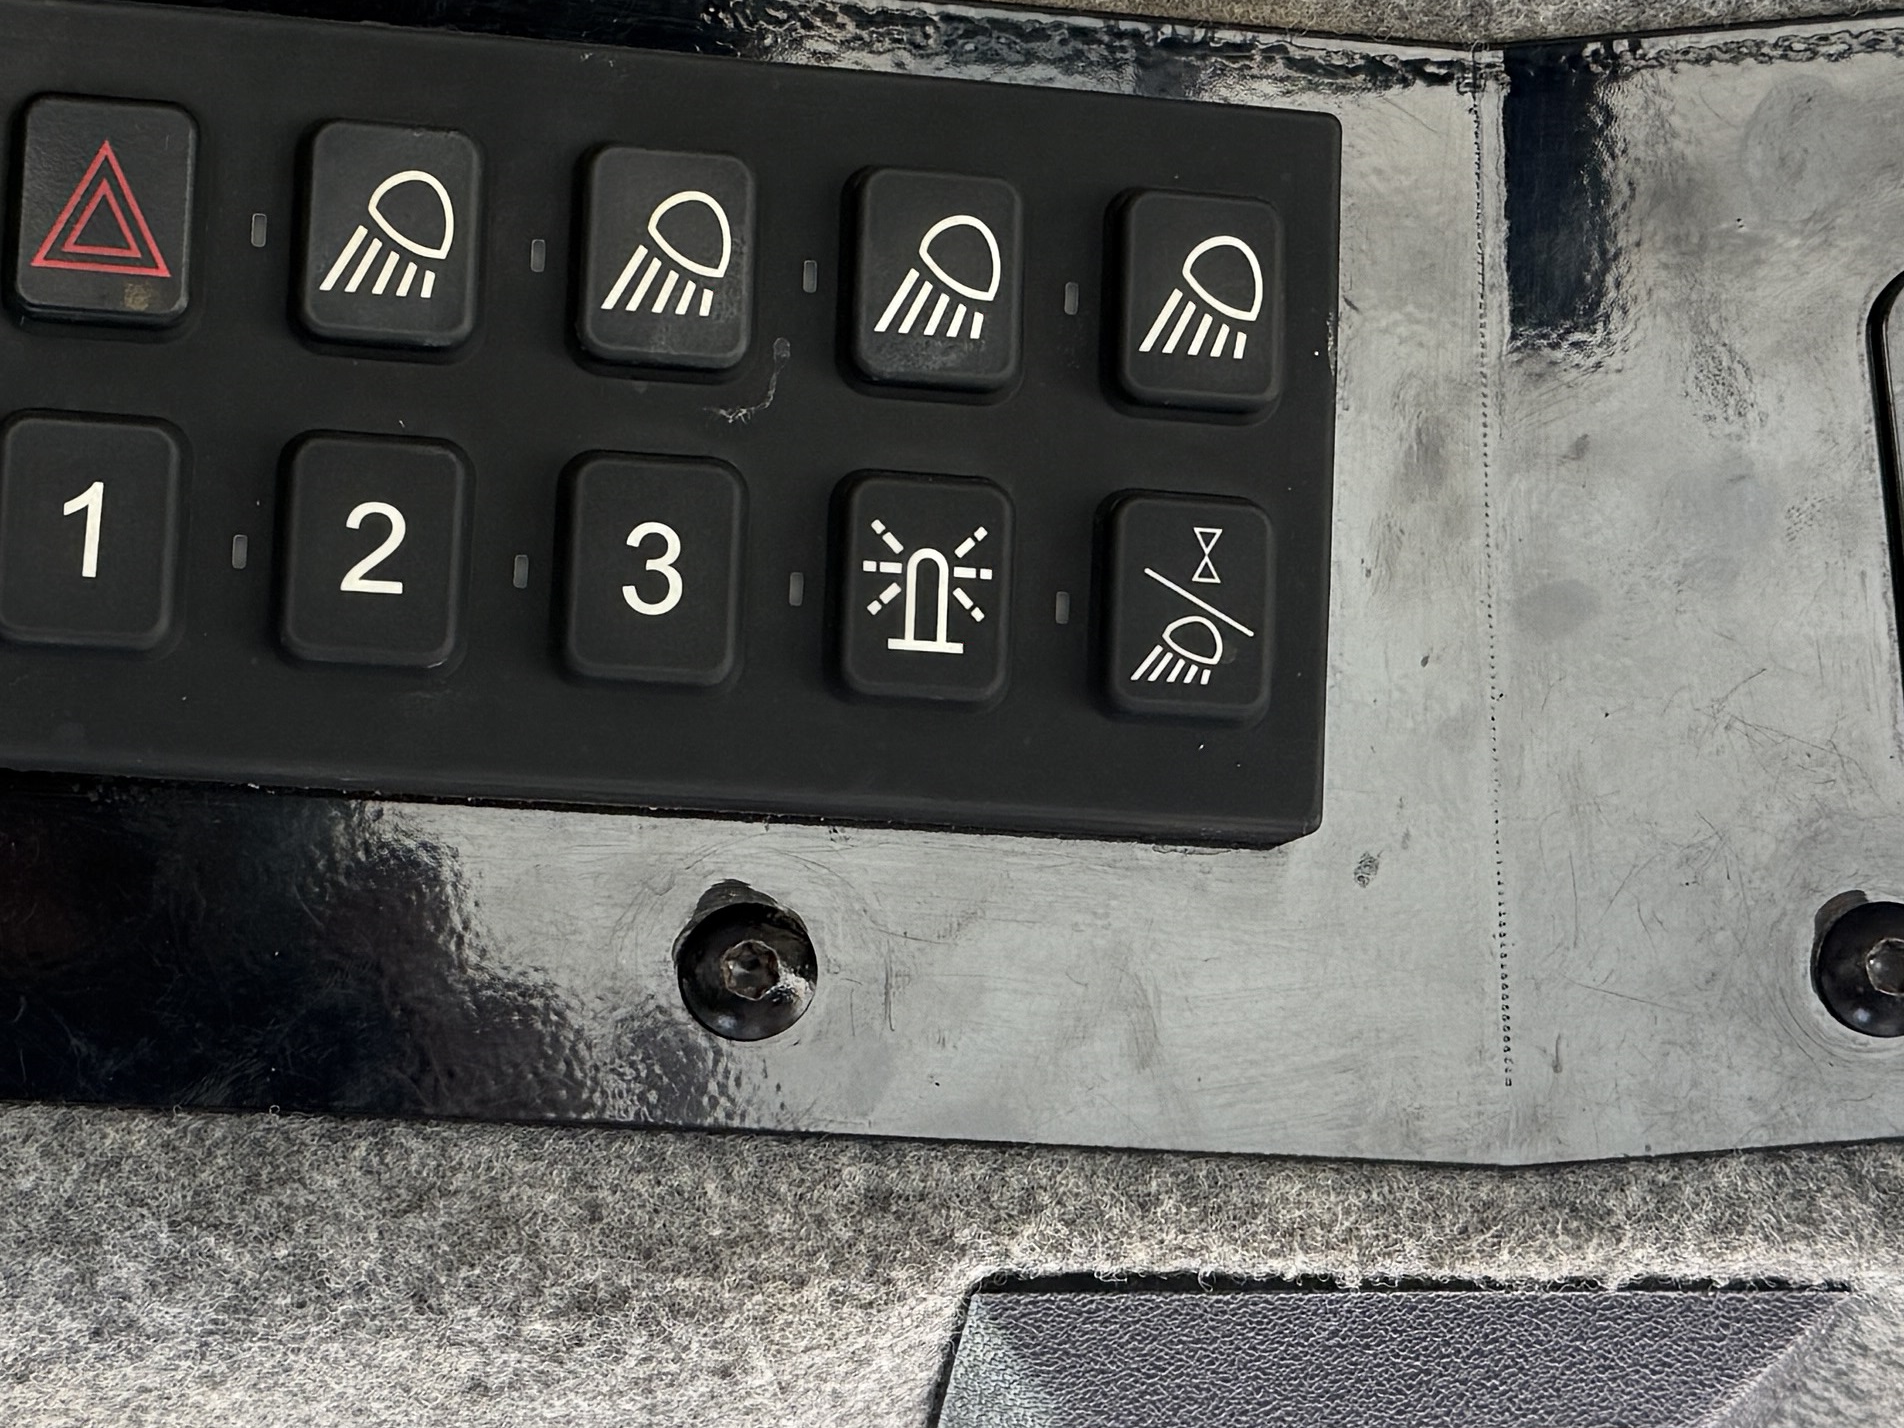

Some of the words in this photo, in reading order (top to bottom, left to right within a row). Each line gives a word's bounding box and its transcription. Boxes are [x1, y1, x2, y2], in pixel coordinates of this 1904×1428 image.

[62, 481, 105, 579] 1
[340, 501, 408, 595] 2
[621, 521, 684, 616] 3
